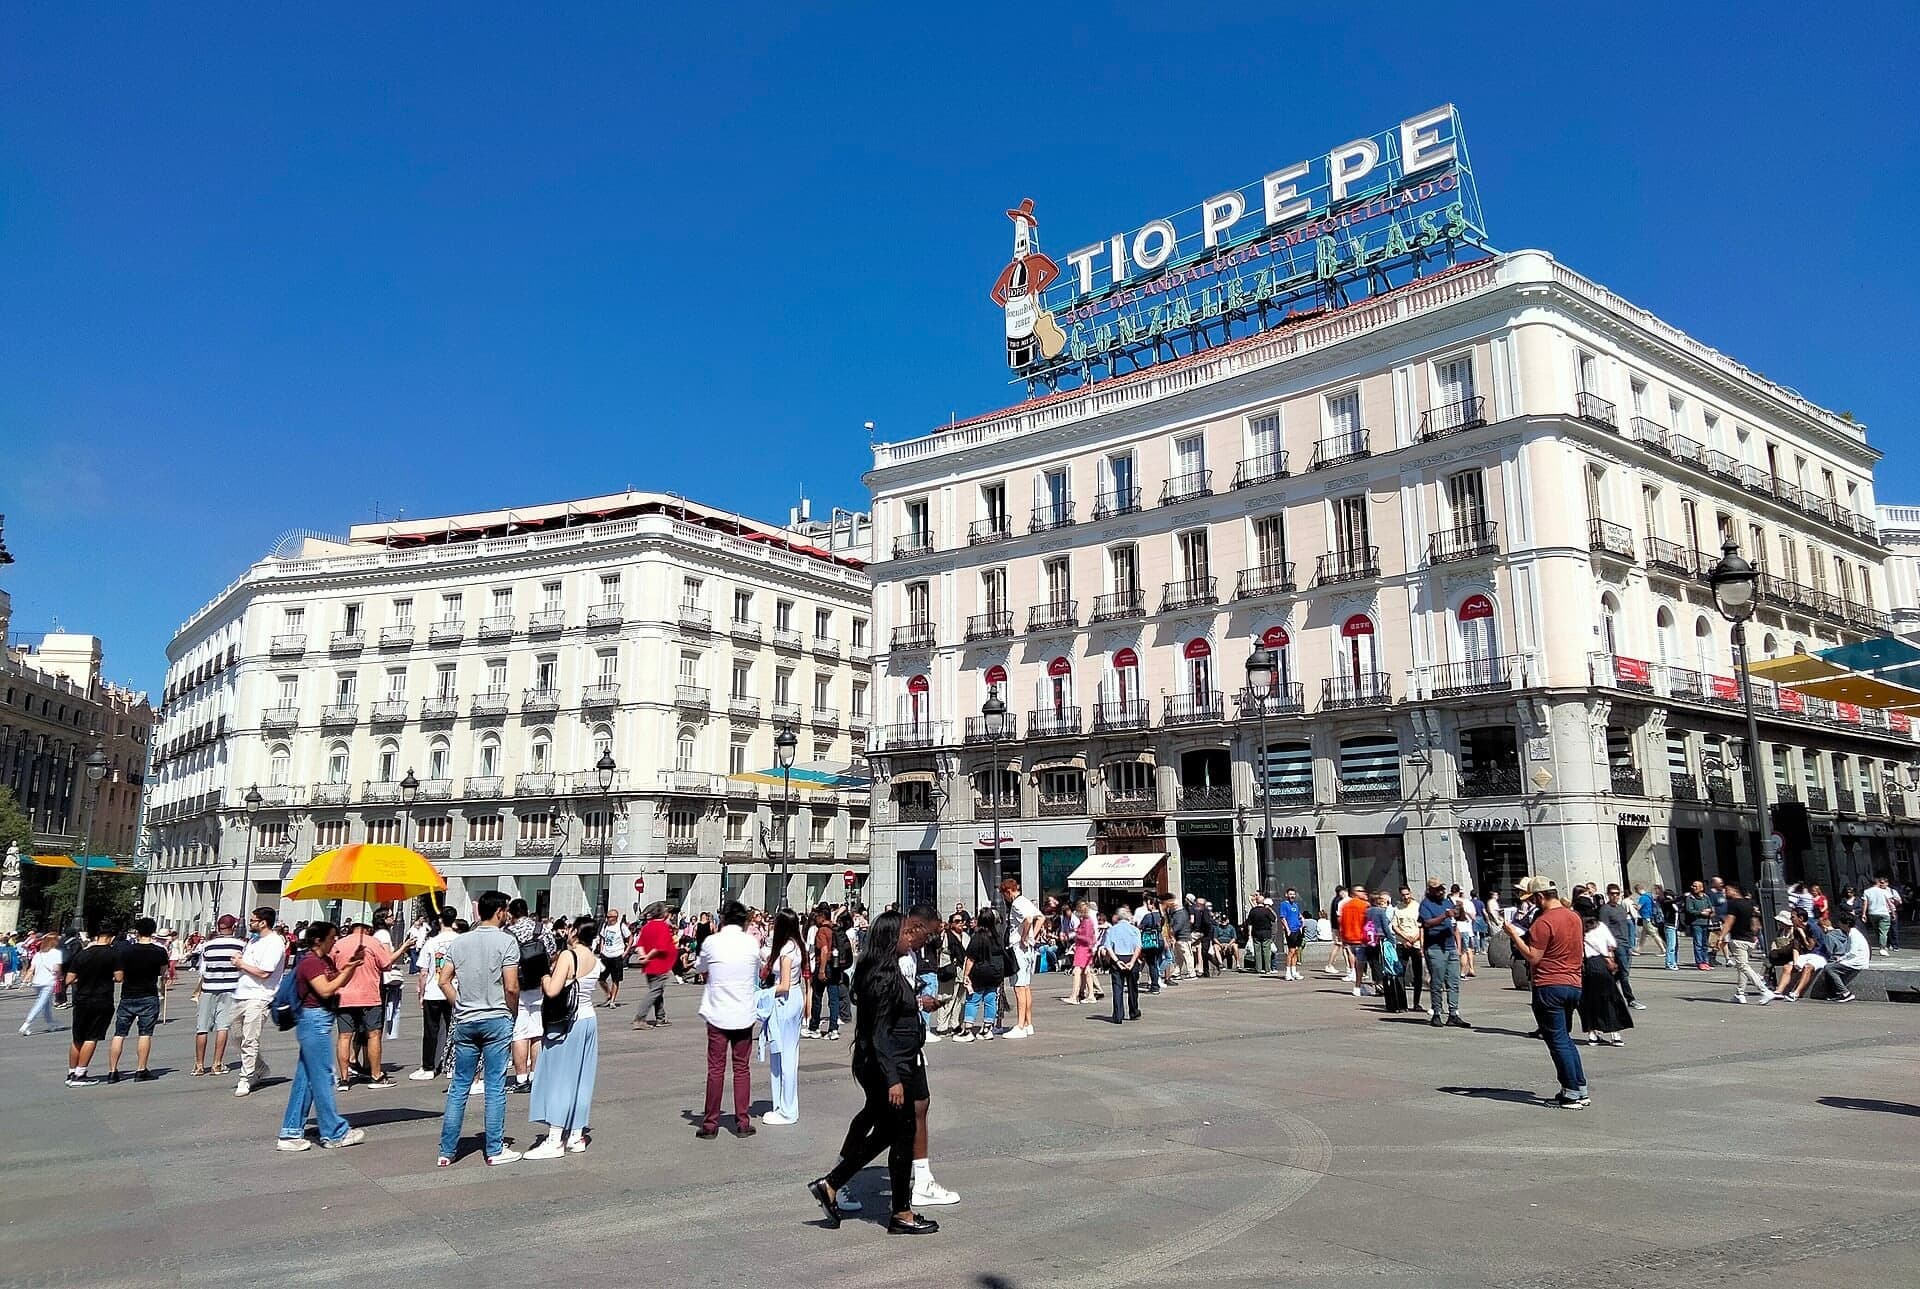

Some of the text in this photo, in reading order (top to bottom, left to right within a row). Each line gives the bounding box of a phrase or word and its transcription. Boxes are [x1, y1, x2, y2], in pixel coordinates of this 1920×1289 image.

[1067, 102, 1455, 295] TIO PEPE
[1066, 174, 1457, 324] SOL DE ANDALUCIA EMBOTELLADO
[1316, 202, 1466, 281] BYASS
[1257, 825, 1308, 837] SPHORA
[1460, 818, 1520, 828] SEPHORA
[1618, 812, 1650, 822] SEPHORA
